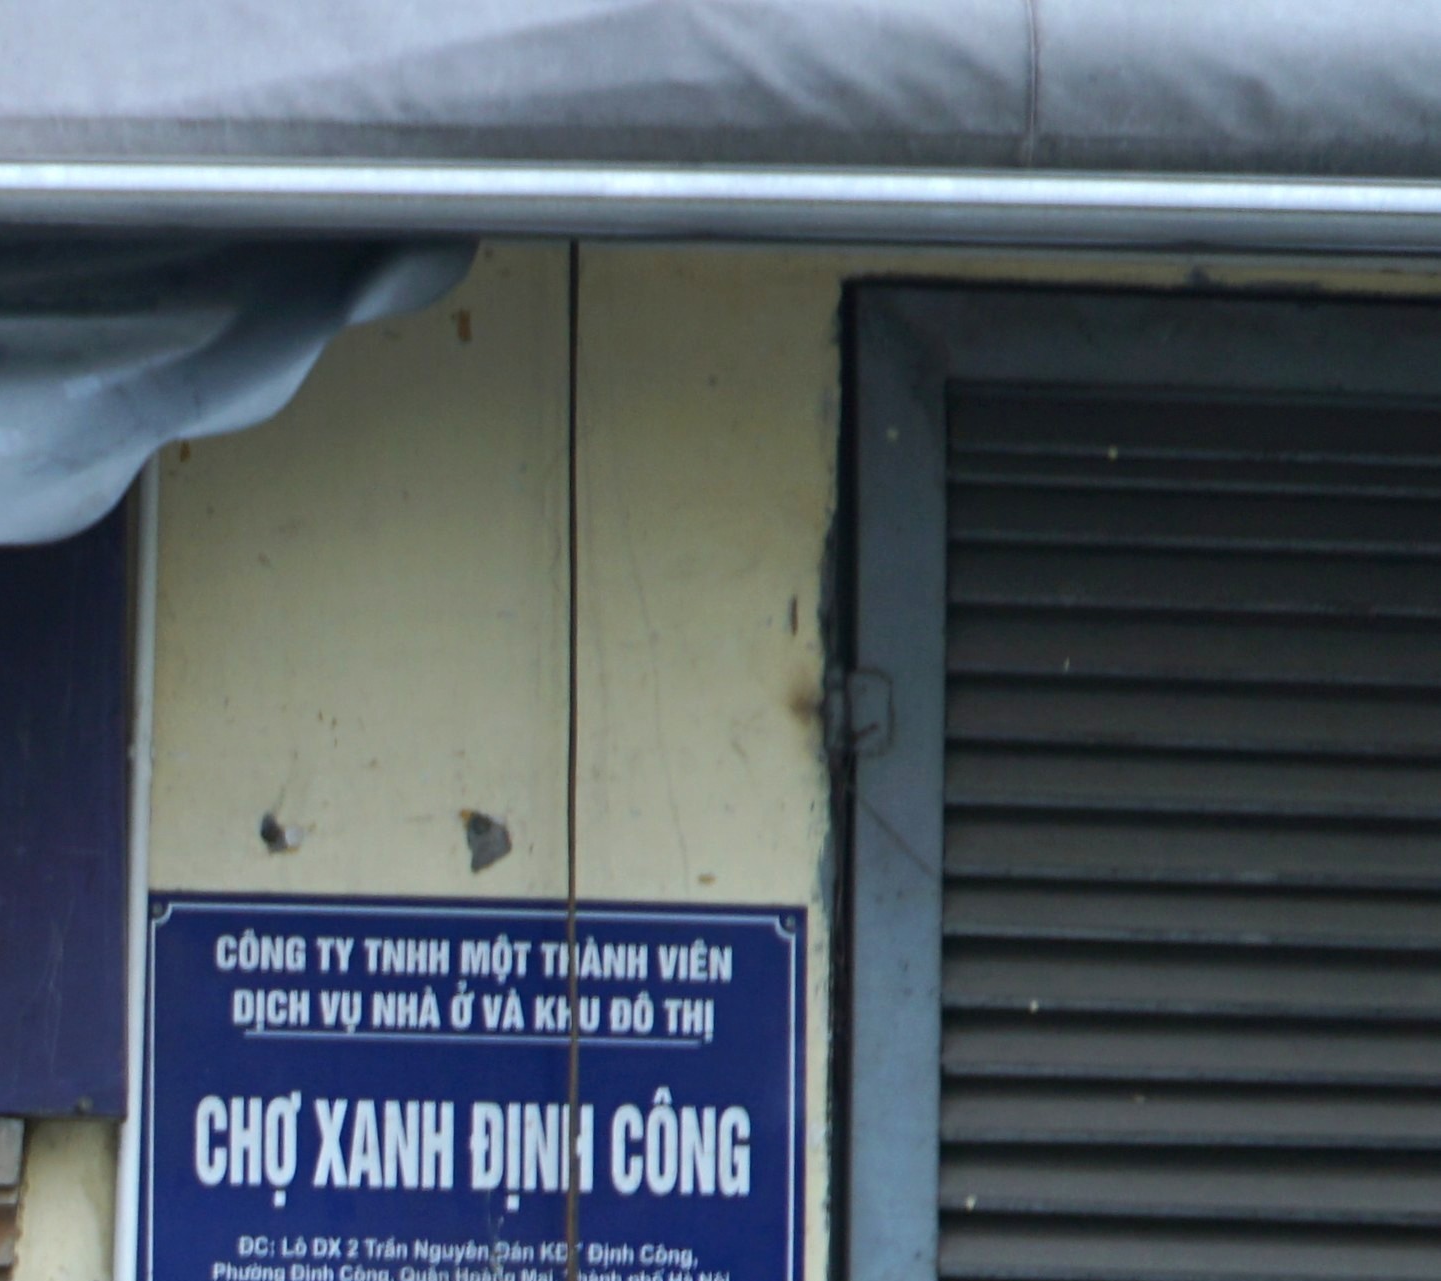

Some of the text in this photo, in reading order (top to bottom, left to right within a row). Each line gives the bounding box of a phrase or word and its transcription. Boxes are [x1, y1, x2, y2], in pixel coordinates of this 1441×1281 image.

[215, 929, 307, 973] CÔNG
[317, 936, 355, 973] TY
[363, 937, 451, 975] TNHH
[459, 933, 532, 985] MỘT
[658, 938, 733, 983] VIÊN
[232, 979, 716, 1043] DỊCH VỤ NHÀ Ở VÀ KHU ĐÔ THỊ
[194, 1085, 752, 1211] CHỢ XANH ĐỊNH CÔNG
